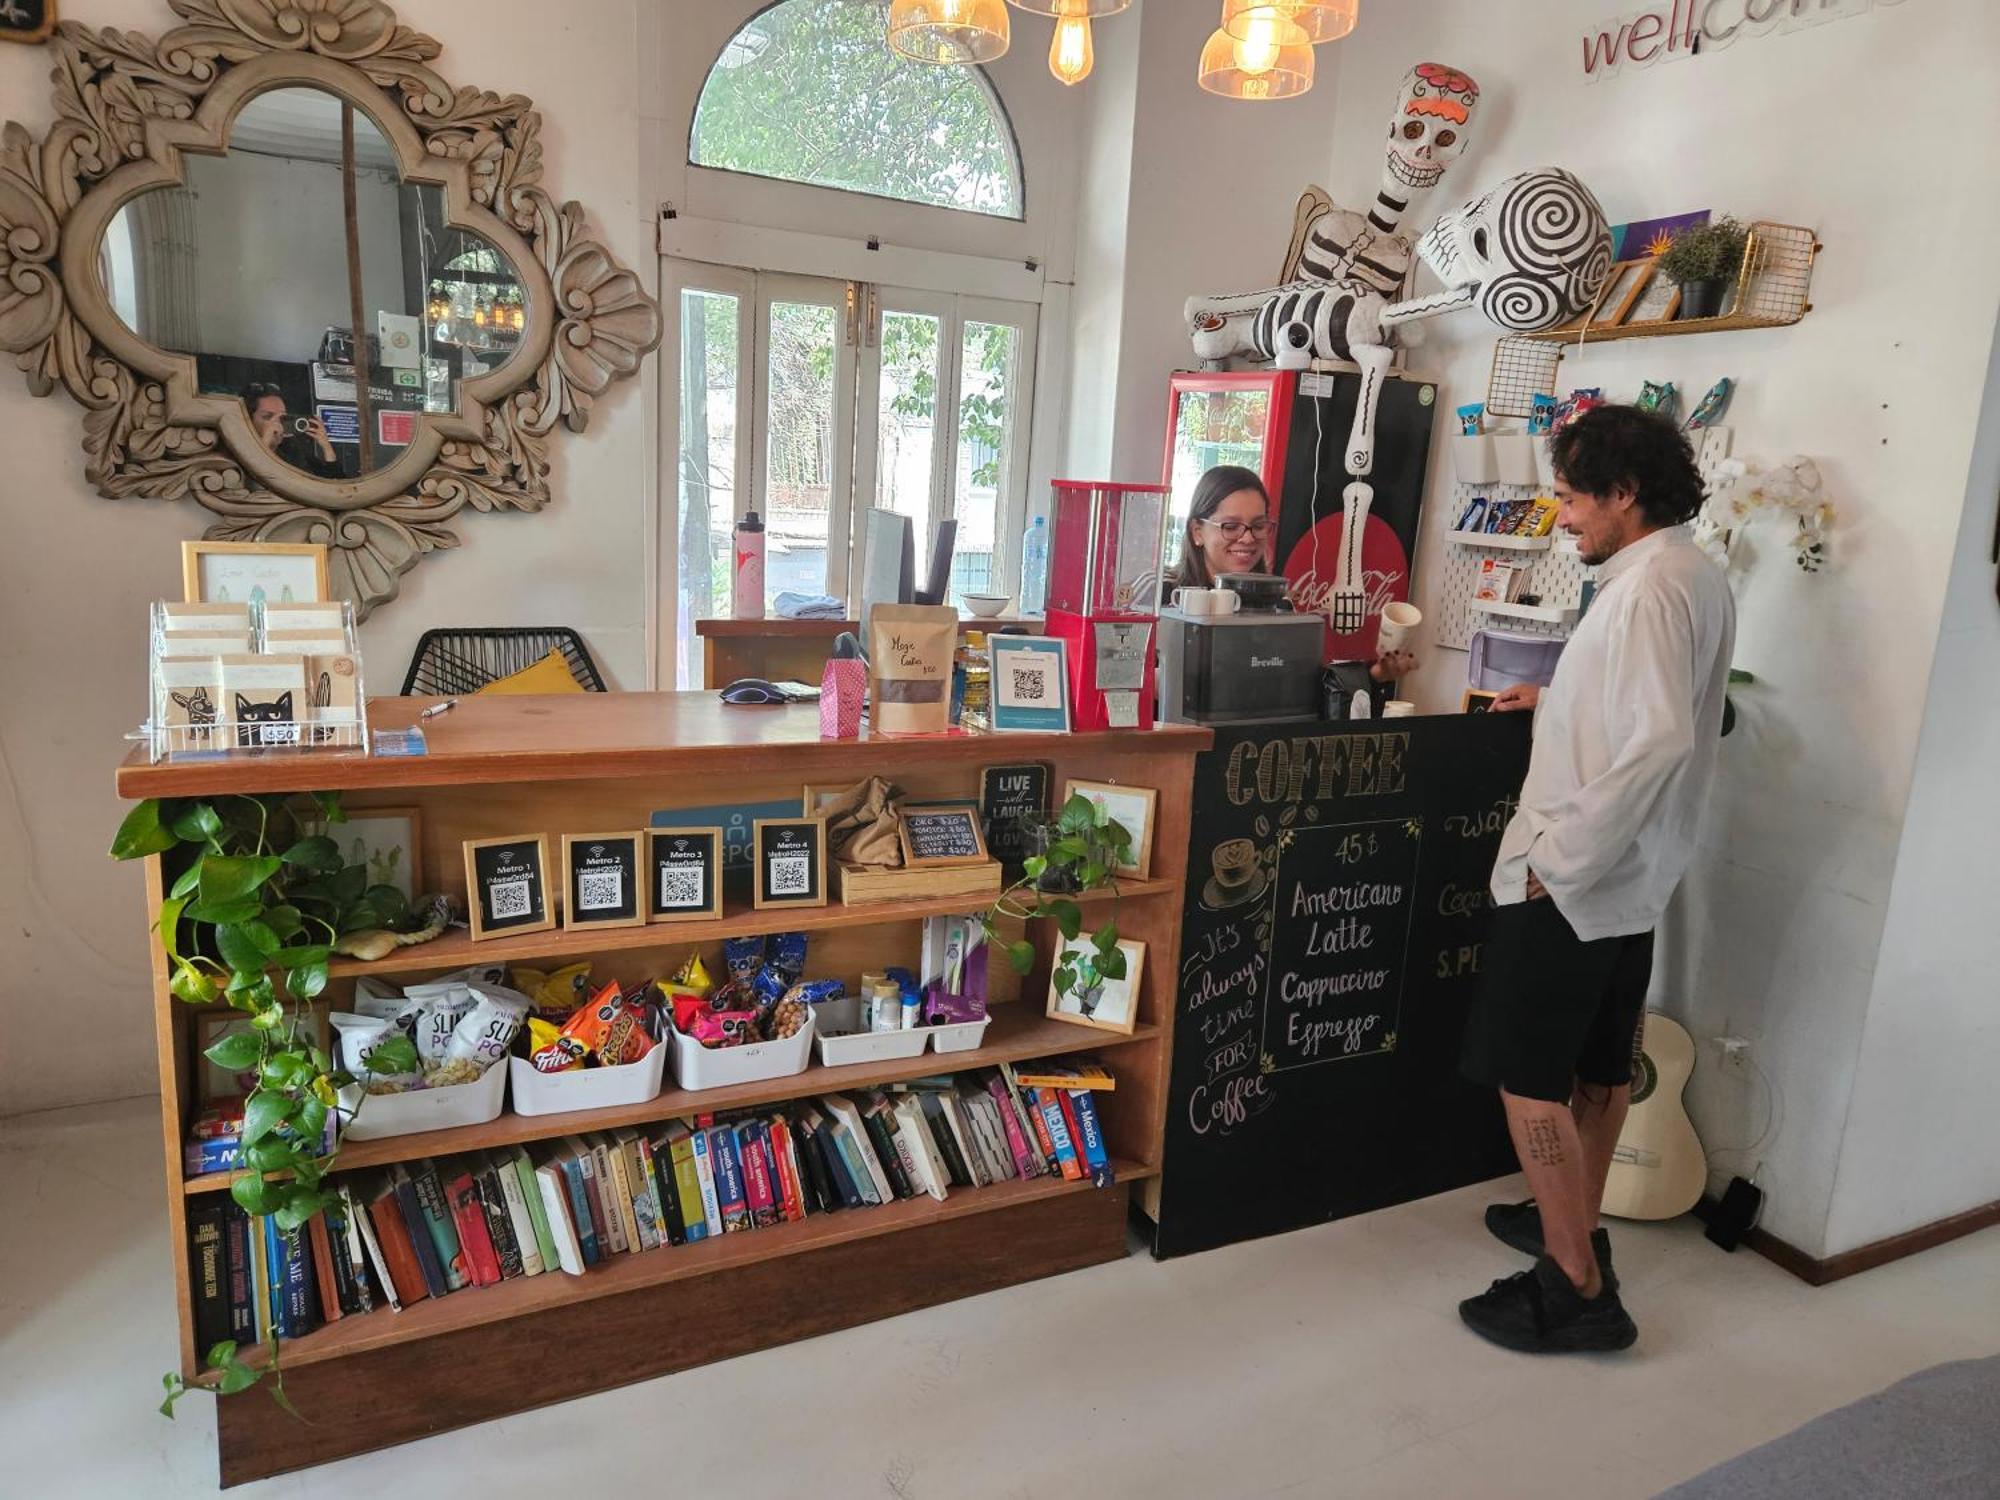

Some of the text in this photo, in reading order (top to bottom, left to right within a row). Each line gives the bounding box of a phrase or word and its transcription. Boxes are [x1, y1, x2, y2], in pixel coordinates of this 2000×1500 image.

[1250, 656, 1285, 668] Breville
[999, 775, 1031, 791] LIVE
[1225, 732, 1410, 805] COFFEE
[496, 866, 524, 874] Metro
[615, 856, 621, 864] 2
[1292, 882, 1402, 918] Americano
[1306, 916, 1375, 957] Latte
[1189, 954, 1265, 1012] always
[1281, 968, 1390, 1007] Cappuccino
[485, 1019, 513, 1044] SLI
[1201, 1000, 1255, 1044] time
[431, 1034, 452, 1049] PO
[477, 1040, 505, 1057] PO
[1214, 1045, 1246, 1073] FOR
[1189, 1076, 1269, 1134] Coffee
[1045, 1106, 1070, 1150] MEXICO
[1081, 1109, 1097, 1149] Mexico
[722, 1147, 737, 1200] south america
[750, 1143, 766, 1199] south america
[897, 1139, 916, 1174] MEXIKO
